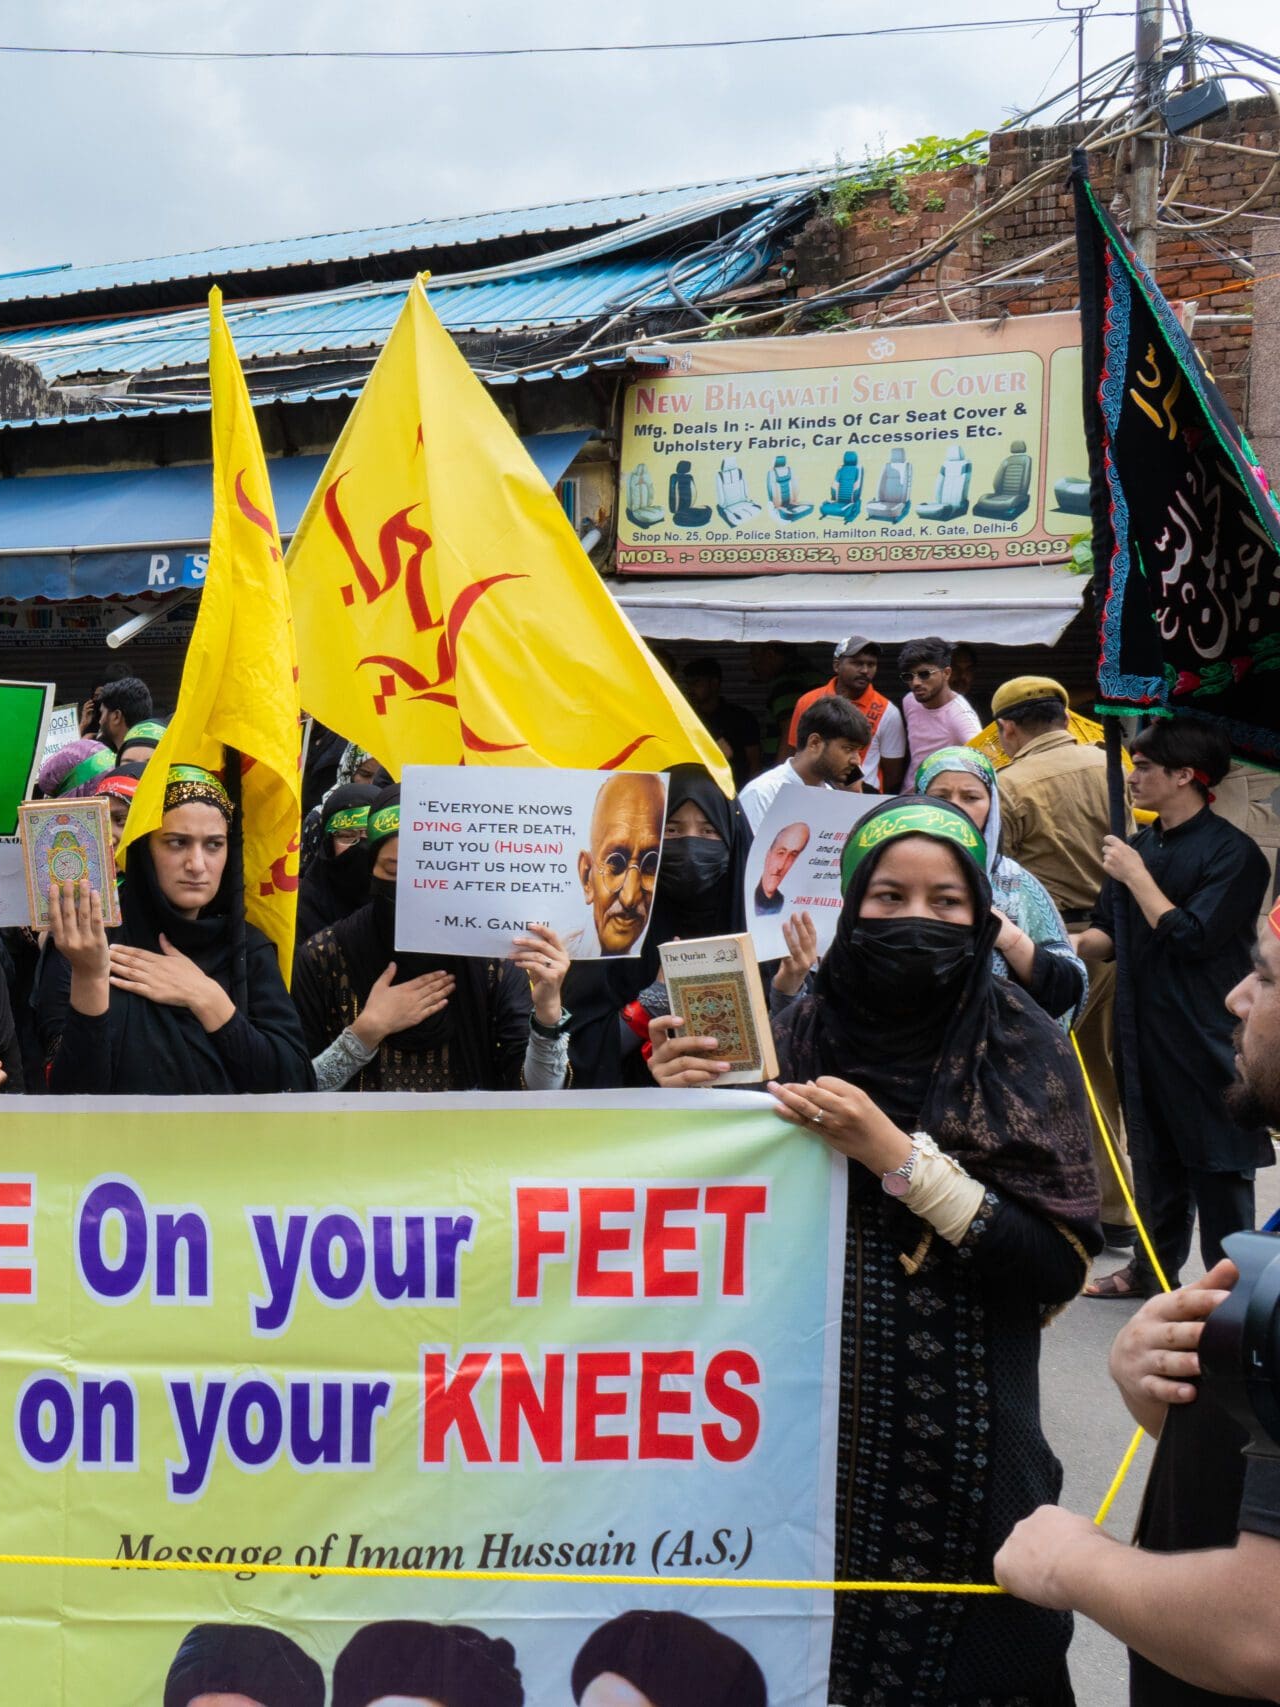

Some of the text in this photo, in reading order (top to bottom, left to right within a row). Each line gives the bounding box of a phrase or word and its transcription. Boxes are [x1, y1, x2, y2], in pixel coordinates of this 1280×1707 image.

[634, 424, 667, 438] Mfg.
[673, 421, 718, 435] Deals
[724, 421, 739, 433] In
[760, 418, 782, 431] All
[788, 415, 836, 430] Kinds
[843, 413, 863, 427] Of
[869, 411, 900, 426] Car
[906, 409, 947, 423] Seat
[953, 405, 1007, 420] Cover
[1013, 402, 1027, 415] &
[653, 424, 1003, 454] Upholstery Fabric, Car Accessories Etc.
[632, 522, 1018, 543] Shop No. 25, Opp. Police Station, Hamilton Road, K. Gate, Delhi-6
[619, 550, 673, 563] MOB.
[699, 548, 841, 565] 9899983852,
[847, 544, 999, 562] 9818375399,
[1006, 540, 1070, 556] 9899
[147, 554, 175, 585] R.
[518, 804, 573, 816] KNOWS
[413, 821, 576, 836] DYING AFTER DEATH,
[818, 830, 834, 840] Let
[422, 840, 564, 854] BUT YOU (HUSAIN)
[816, 845, 835, 853] and
[416, 859, 568, 874] TAUGHT US HOW TO
[808, 857, 830, 866] claim
[413, 878, 449, 890] LIVE
[453, 880, 505, 892] AFTER
[444, 916, 550, 931] M.K. GAND
[664, 954, 678, 962] The
[78, 1181, 209, 1298] On
[252, 1213, 472, 1331] your
[515, 1185, 767, 1298] FEET
[19, 1378, 135, 1464] on
[170, 1381, 390, 1496] your
[423, 1350, 761, 1464] KNEES
[111, 1526, 754, 1581] Message of Imam Hussain (A.S.)
